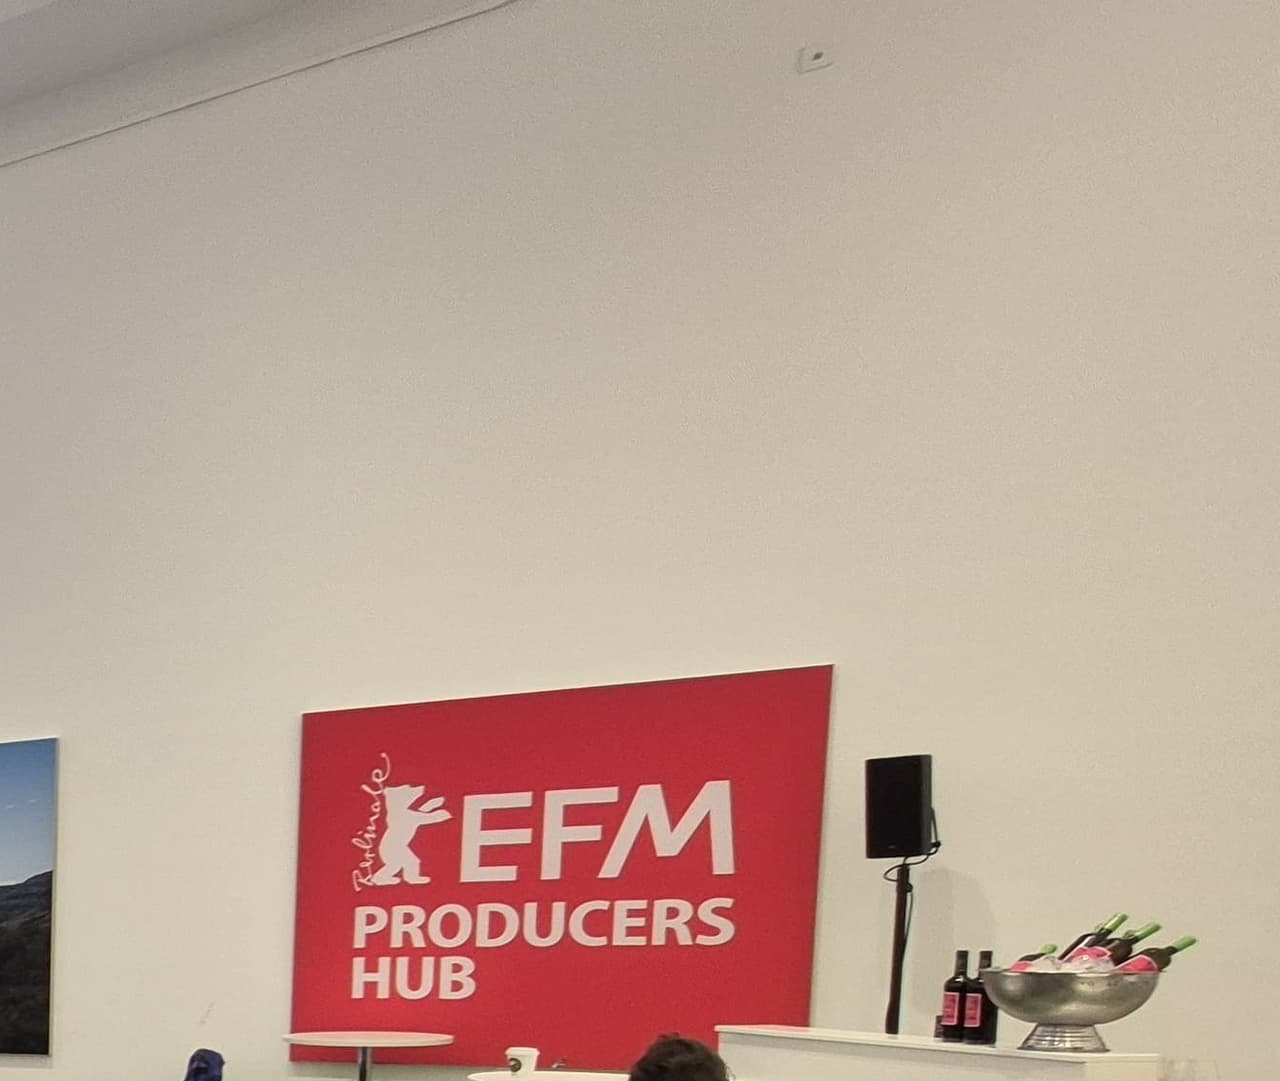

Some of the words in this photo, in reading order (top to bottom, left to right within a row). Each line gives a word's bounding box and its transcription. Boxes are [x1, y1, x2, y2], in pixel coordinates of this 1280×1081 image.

[351, 752, 391, 892] Berlinale
[460, 779, 736, 883] EFM
[352, 897, 737, 949] PRODUCERS
[350, 955, 477, 1000] HUB
